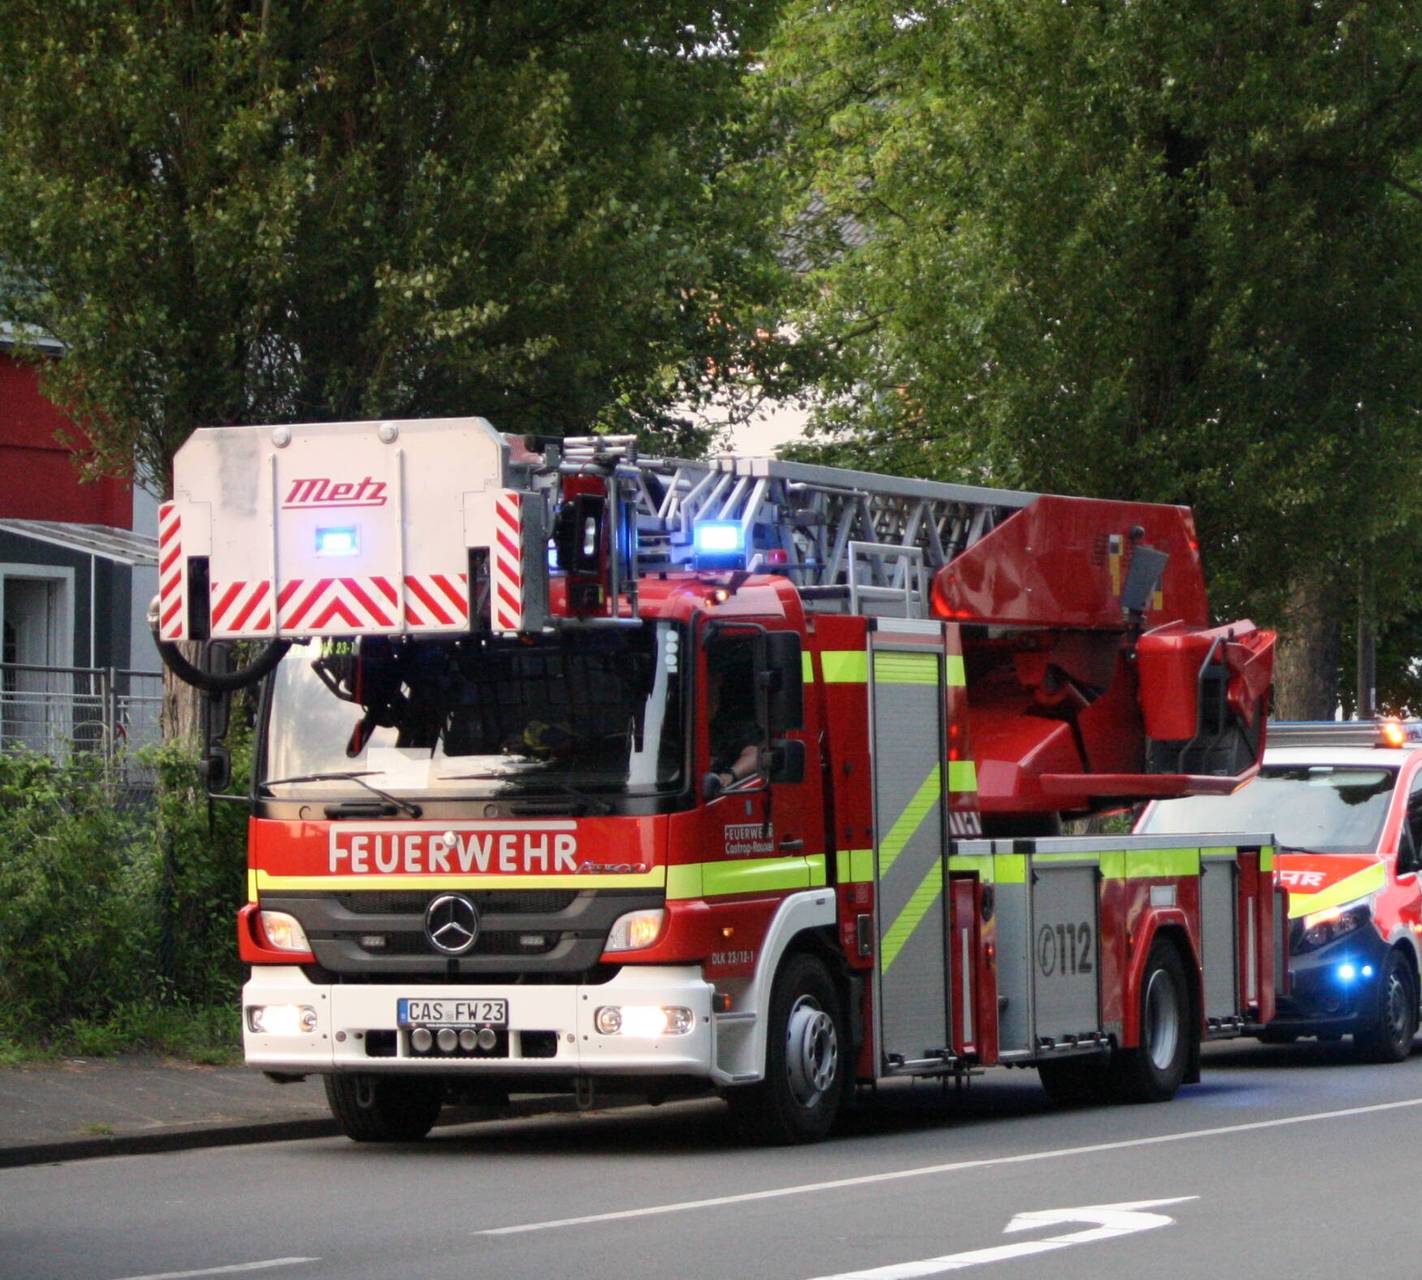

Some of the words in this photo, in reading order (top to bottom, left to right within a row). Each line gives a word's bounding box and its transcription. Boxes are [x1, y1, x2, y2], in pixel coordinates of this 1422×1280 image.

[282, 477, 387, 508] Metz
[329, 821, 577, 873] FEUERWEHR
[1056, 921, 1093, 975] 112
[409, 1002, 443, 1021] CAS
[455, 1002, 478, 1021] FW
[482, 1002, 504, 1021] 23
